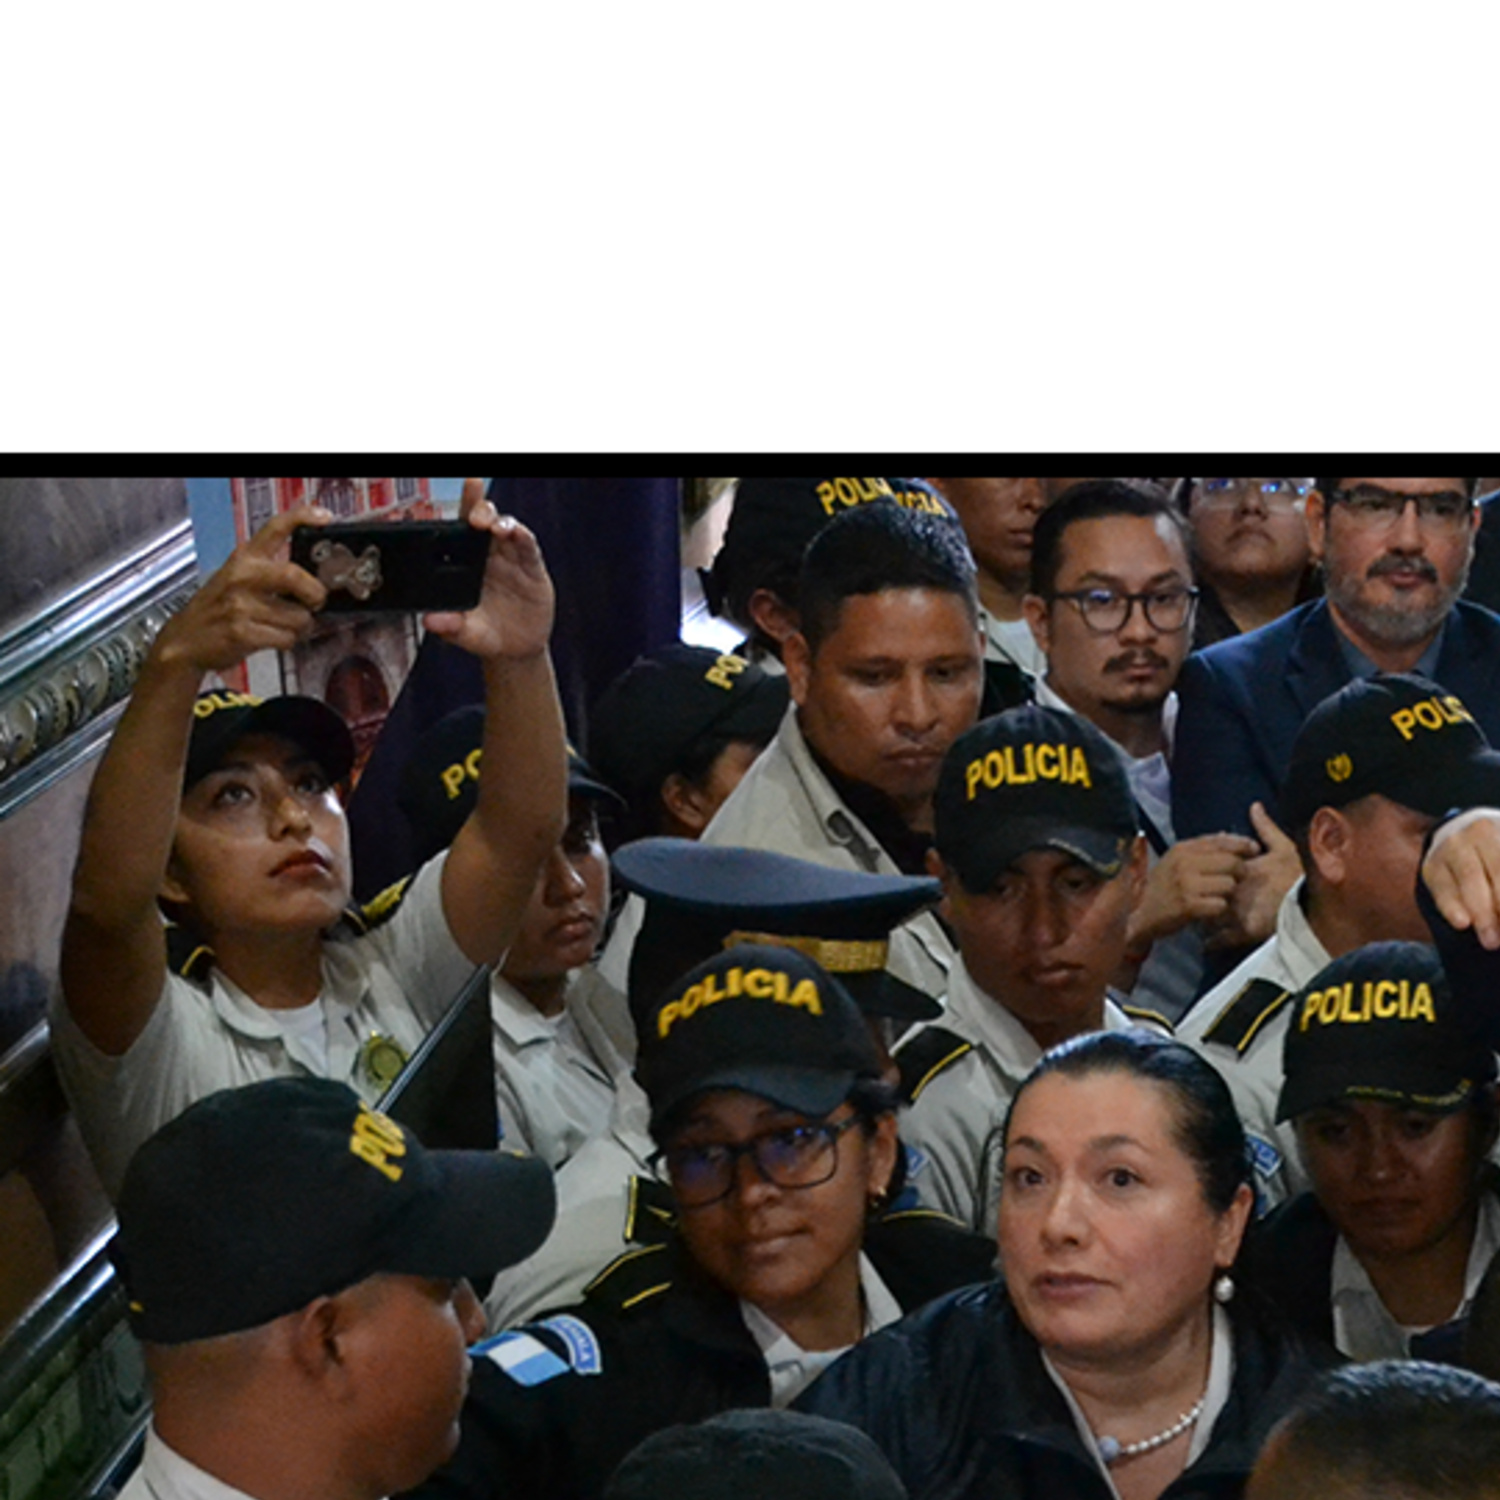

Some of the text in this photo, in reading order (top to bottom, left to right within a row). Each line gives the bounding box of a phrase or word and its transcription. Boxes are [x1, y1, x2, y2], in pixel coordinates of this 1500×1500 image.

[965, 742, 1092, 801] POLICIA
[657, 966, 822, 1040] POLICIA
[1300, 979, 1436, 1032] POLICIA
